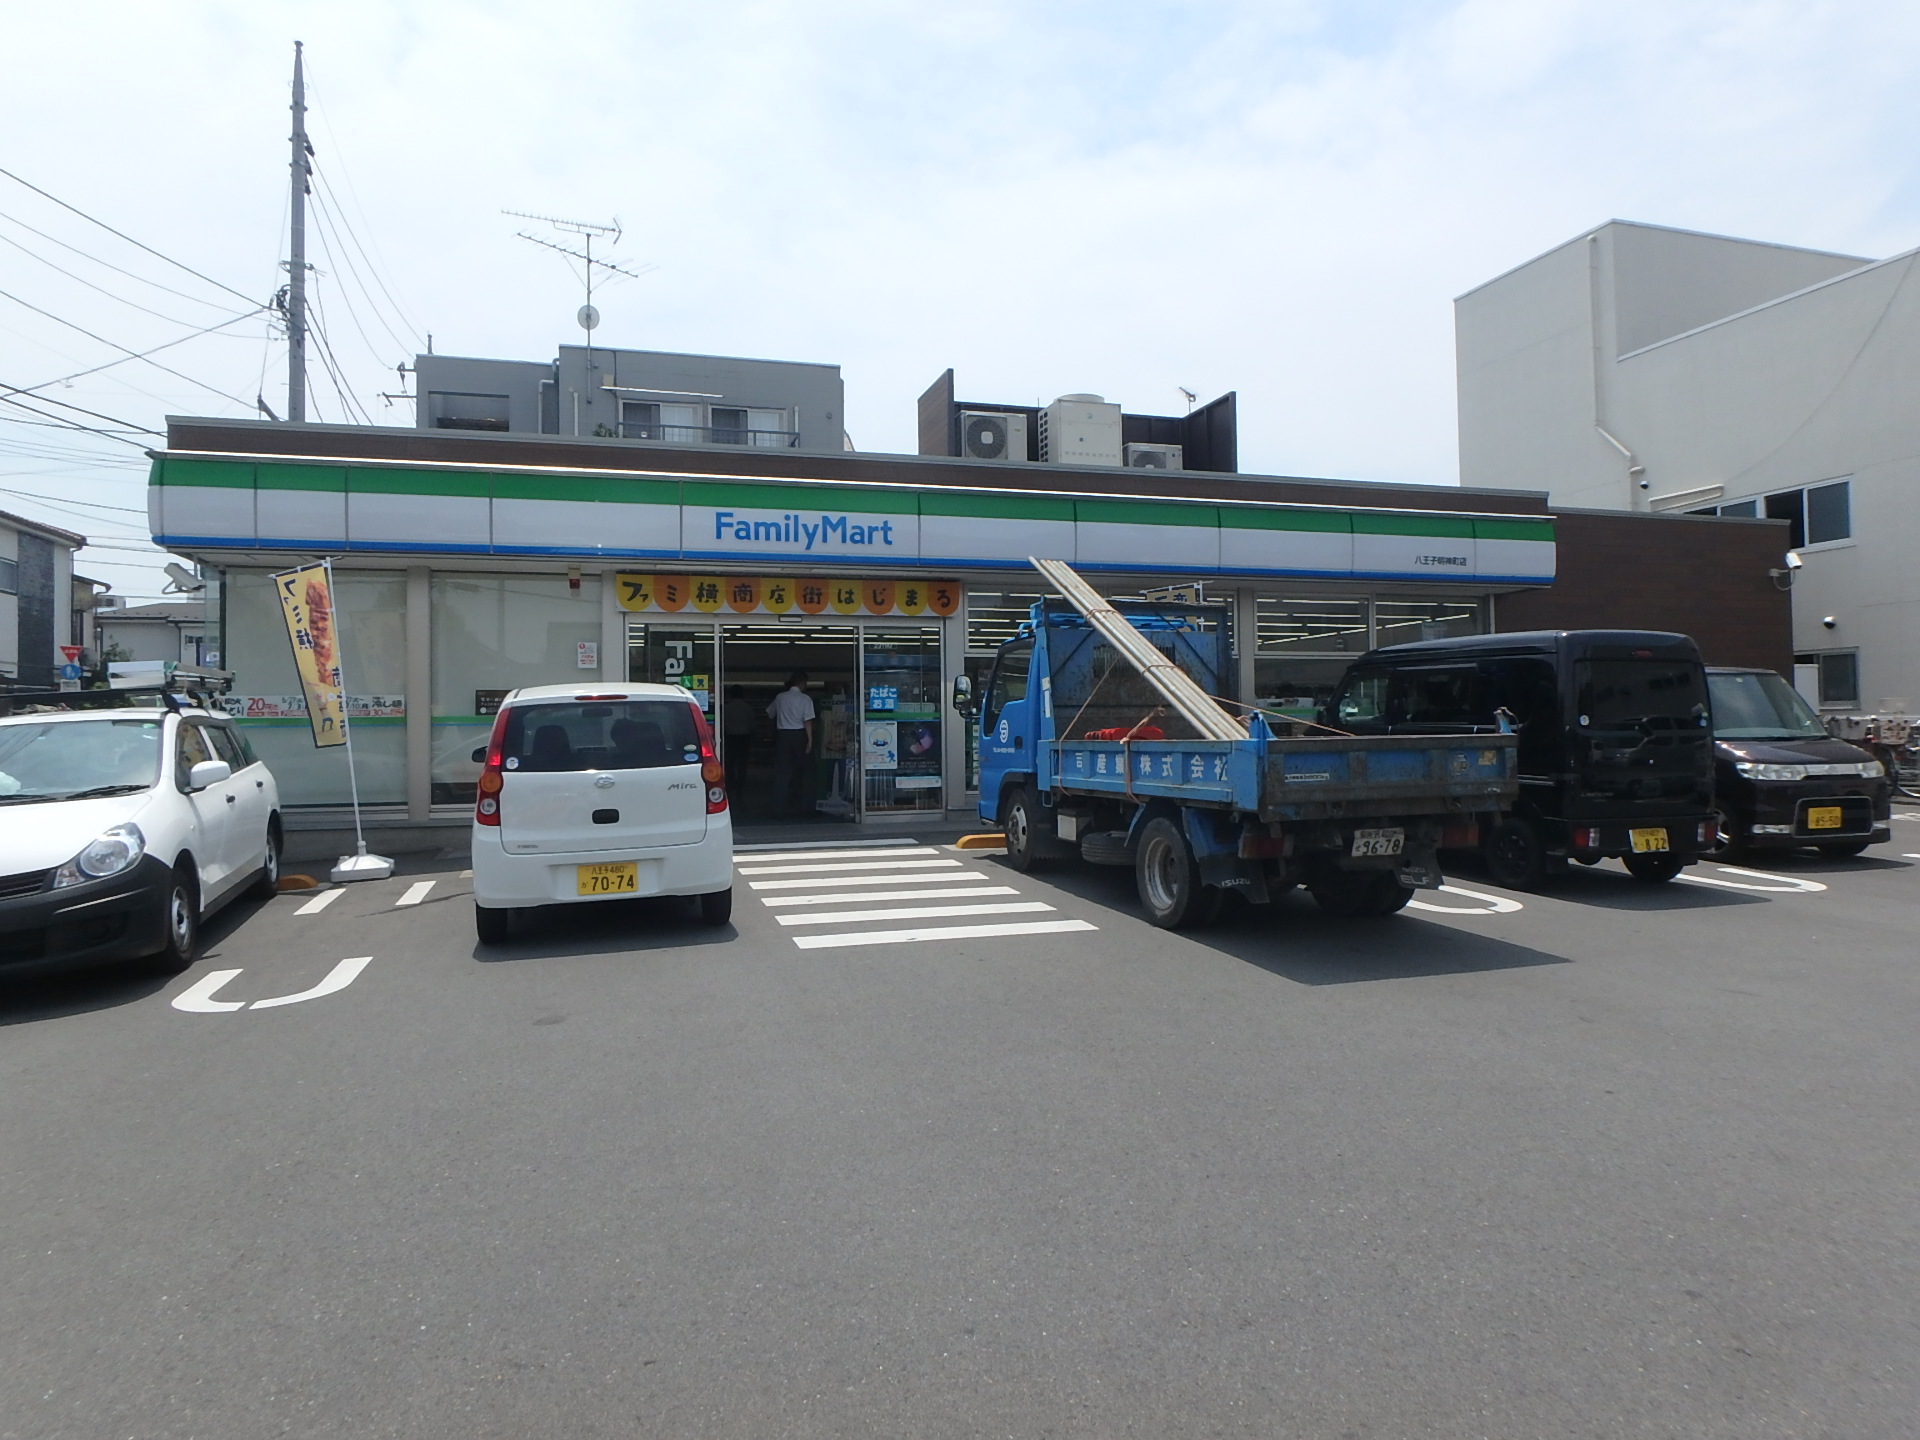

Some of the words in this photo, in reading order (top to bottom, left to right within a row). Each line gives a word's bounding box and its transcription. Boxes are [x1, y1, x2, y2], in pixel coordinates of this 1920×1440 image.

[715, 512, 893, 550] FamilyMart
[622, 580, 951, 609] ファミ横商店街はじまる
[870, 687, 898, 698] たばこ
[667, 782, 698, 791] Mira
[1362, 838, 1401, 855] 96-78
[590, 874, 635, 892] 70-74
[1221, 877, 1250, 887] ISUZU
[1400, 874, 1430, 885] ELF
